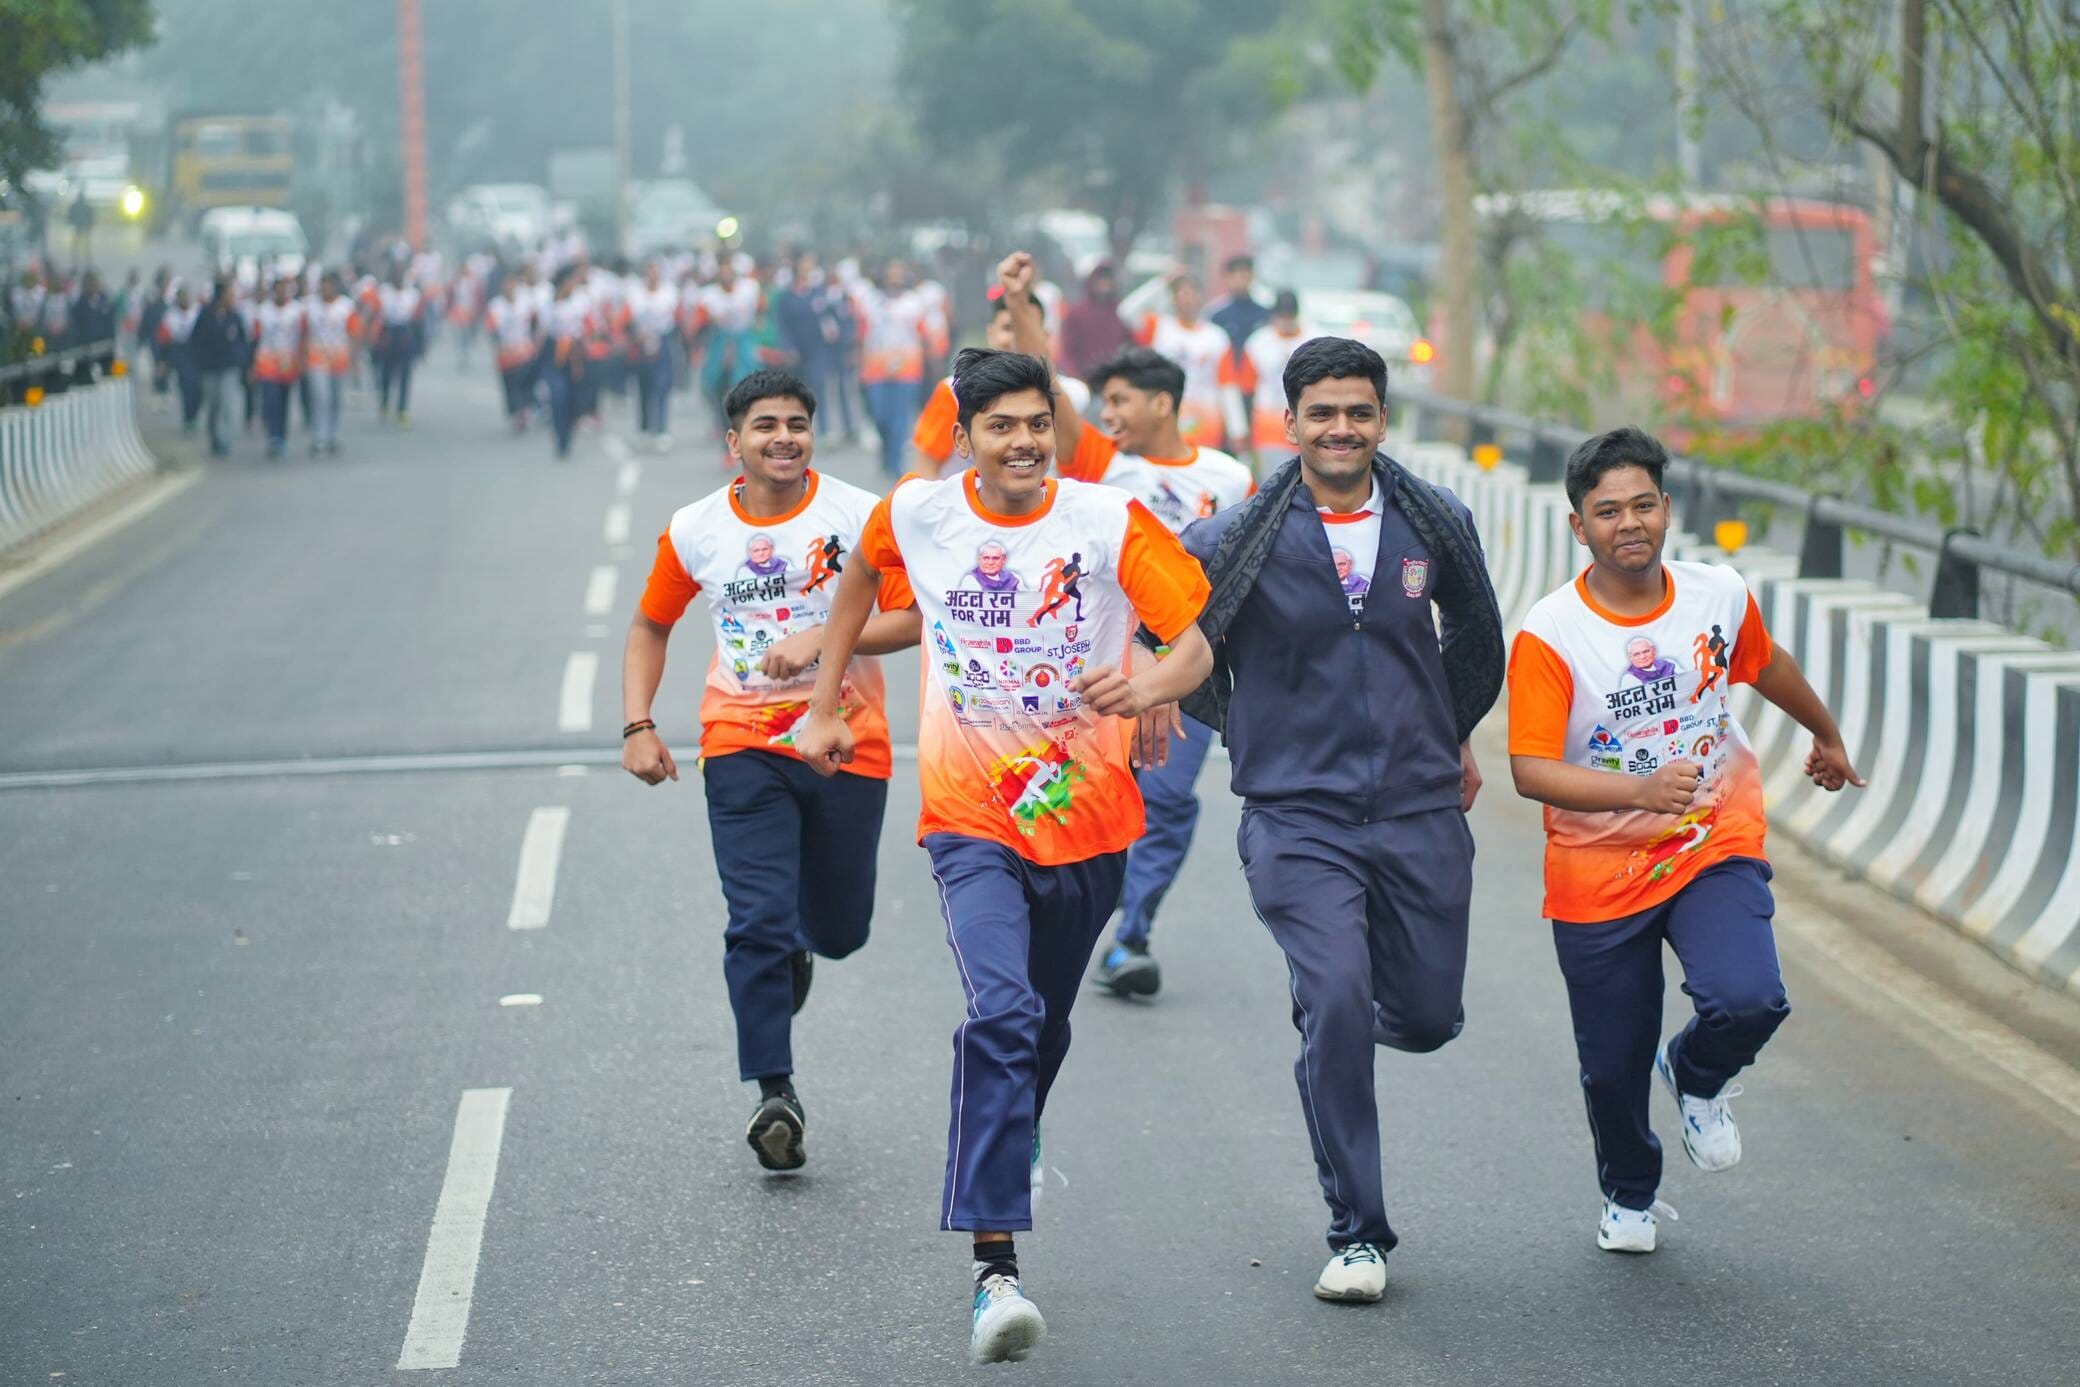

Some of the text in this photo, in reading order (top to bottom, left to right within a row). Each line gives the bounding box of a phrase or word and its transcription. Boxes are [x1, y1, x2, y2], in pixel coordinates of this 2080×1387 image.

[723, 573, 786, 597] अटल रन
[731, 586, 786, 606] FOR राम
[944, 590, 1016, 609] अटल रन
[951, 609, 1011, 628] FOR राम
[1014, 646, 1042, 654] GROUP
[1058, 639, 1091, 659] JOSEPH
[1605, 676, 1677, 710] अटल रन
[1615, 693, 1676, 720] FOR राम
[1680, 714, 1695, 723] BBD
[1681, 720, 1703, 732] GROUP
